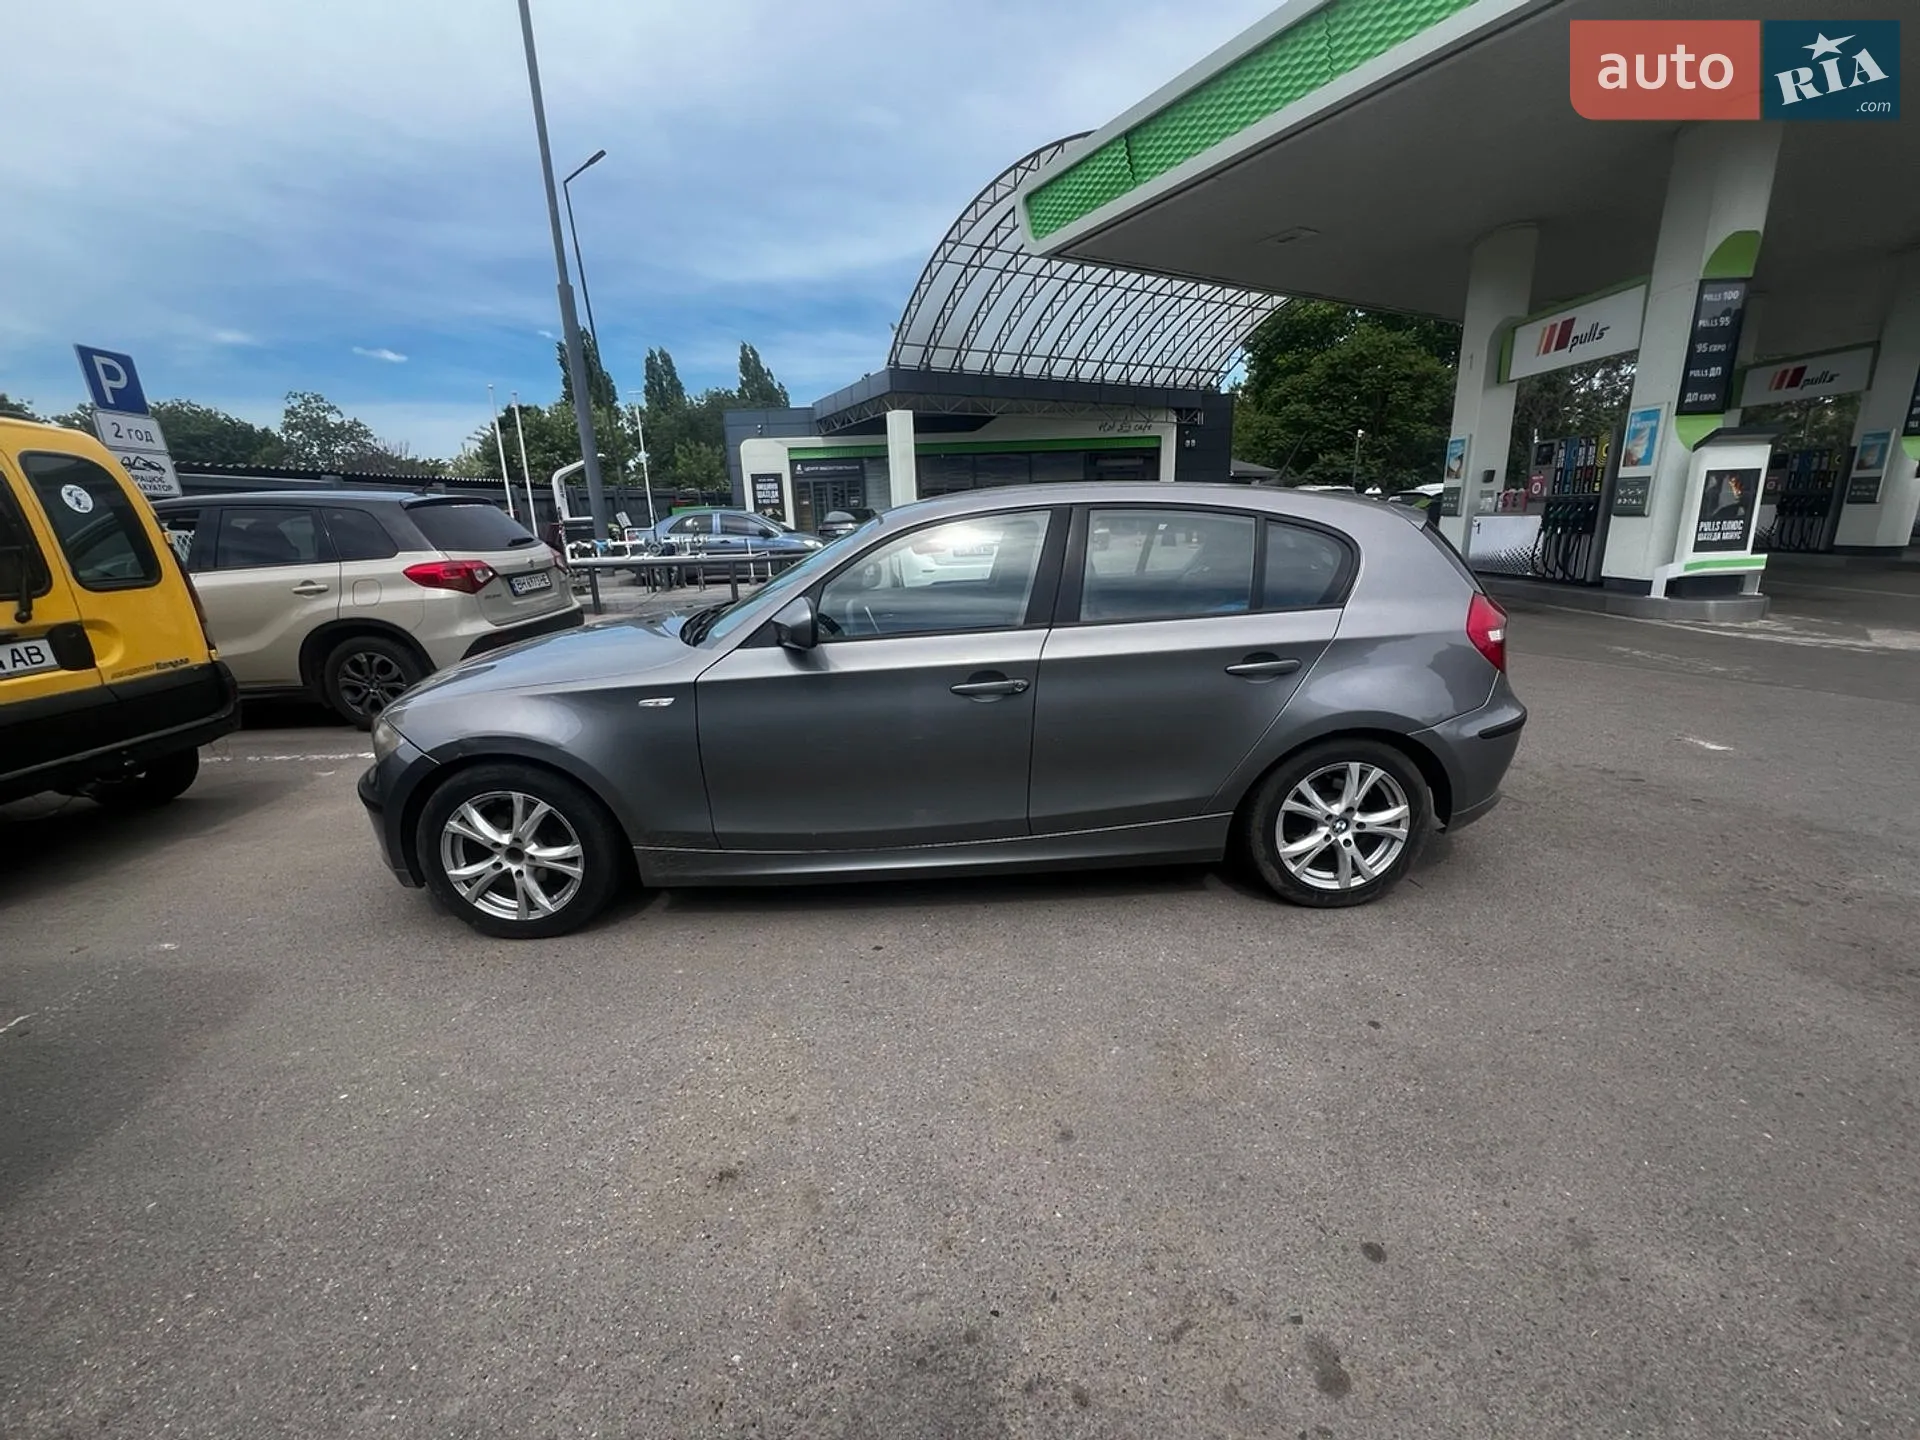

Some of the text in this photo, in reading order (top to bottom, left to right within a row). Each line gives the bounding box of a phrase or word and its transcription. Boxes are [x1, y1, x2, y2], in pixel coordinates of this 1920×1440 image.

[1703, 290, 1740, 302] PULLS 100
[1698, 316, 1731, 328] PULLS 95
[1567, 322, 1611, 353] pulls
[92, 355, 128, 404] P
[1689, 368, 1708, 377] PULLS
[1800, 370, 1840, 390] pulls
[111, 422, 155, 443] 2 год
[1699, 521, 1721, 531] PULLS
[11, 646, 45, 668] AB
